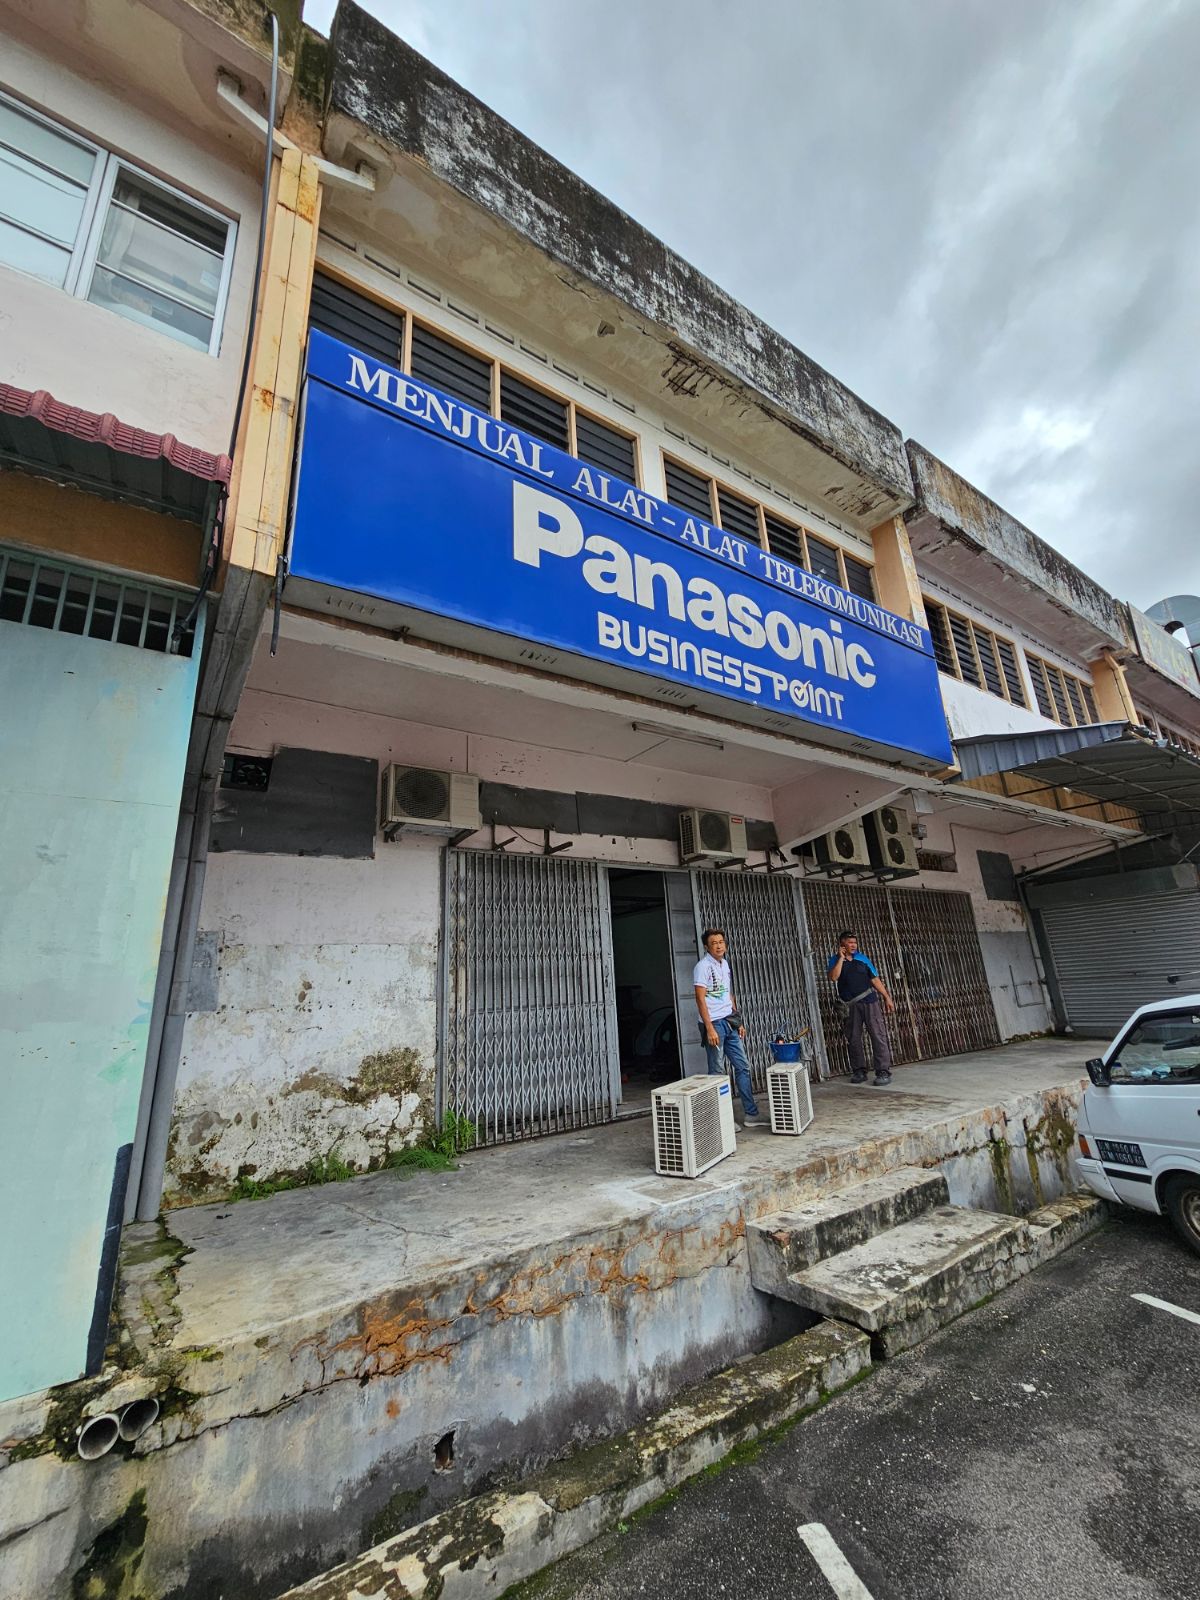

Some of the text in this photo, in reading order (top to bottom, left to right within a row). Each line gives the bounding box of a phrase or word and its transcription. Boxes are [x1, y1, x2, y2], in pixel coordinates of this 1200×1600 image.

[346, 353, 554, 478] MENJUAL
[759, 553, 924, 649] TELEKOMUNIKASI
[512, 479, 876, 689] Panasonic
